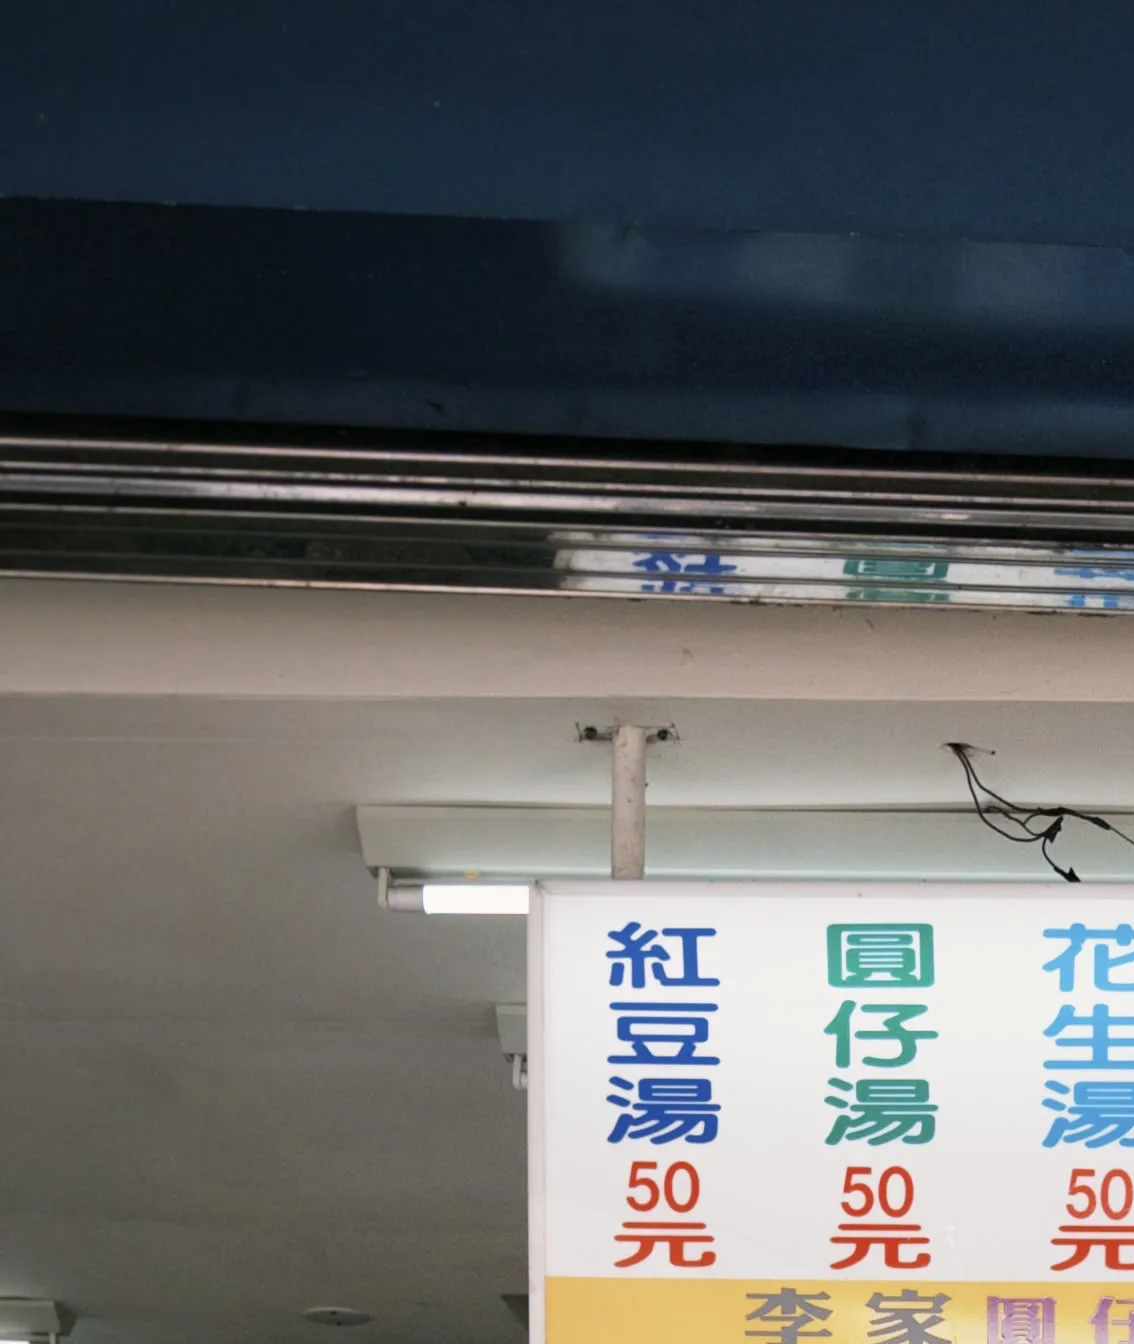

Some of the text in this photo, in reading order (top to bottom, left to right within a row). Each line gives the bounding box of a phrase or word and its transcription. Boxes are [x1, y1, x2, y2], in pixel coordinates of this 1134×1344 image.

[606, 921, 721, 1145] 紅豆湯
[824, 923, 939, 1146] 圓仔湯
